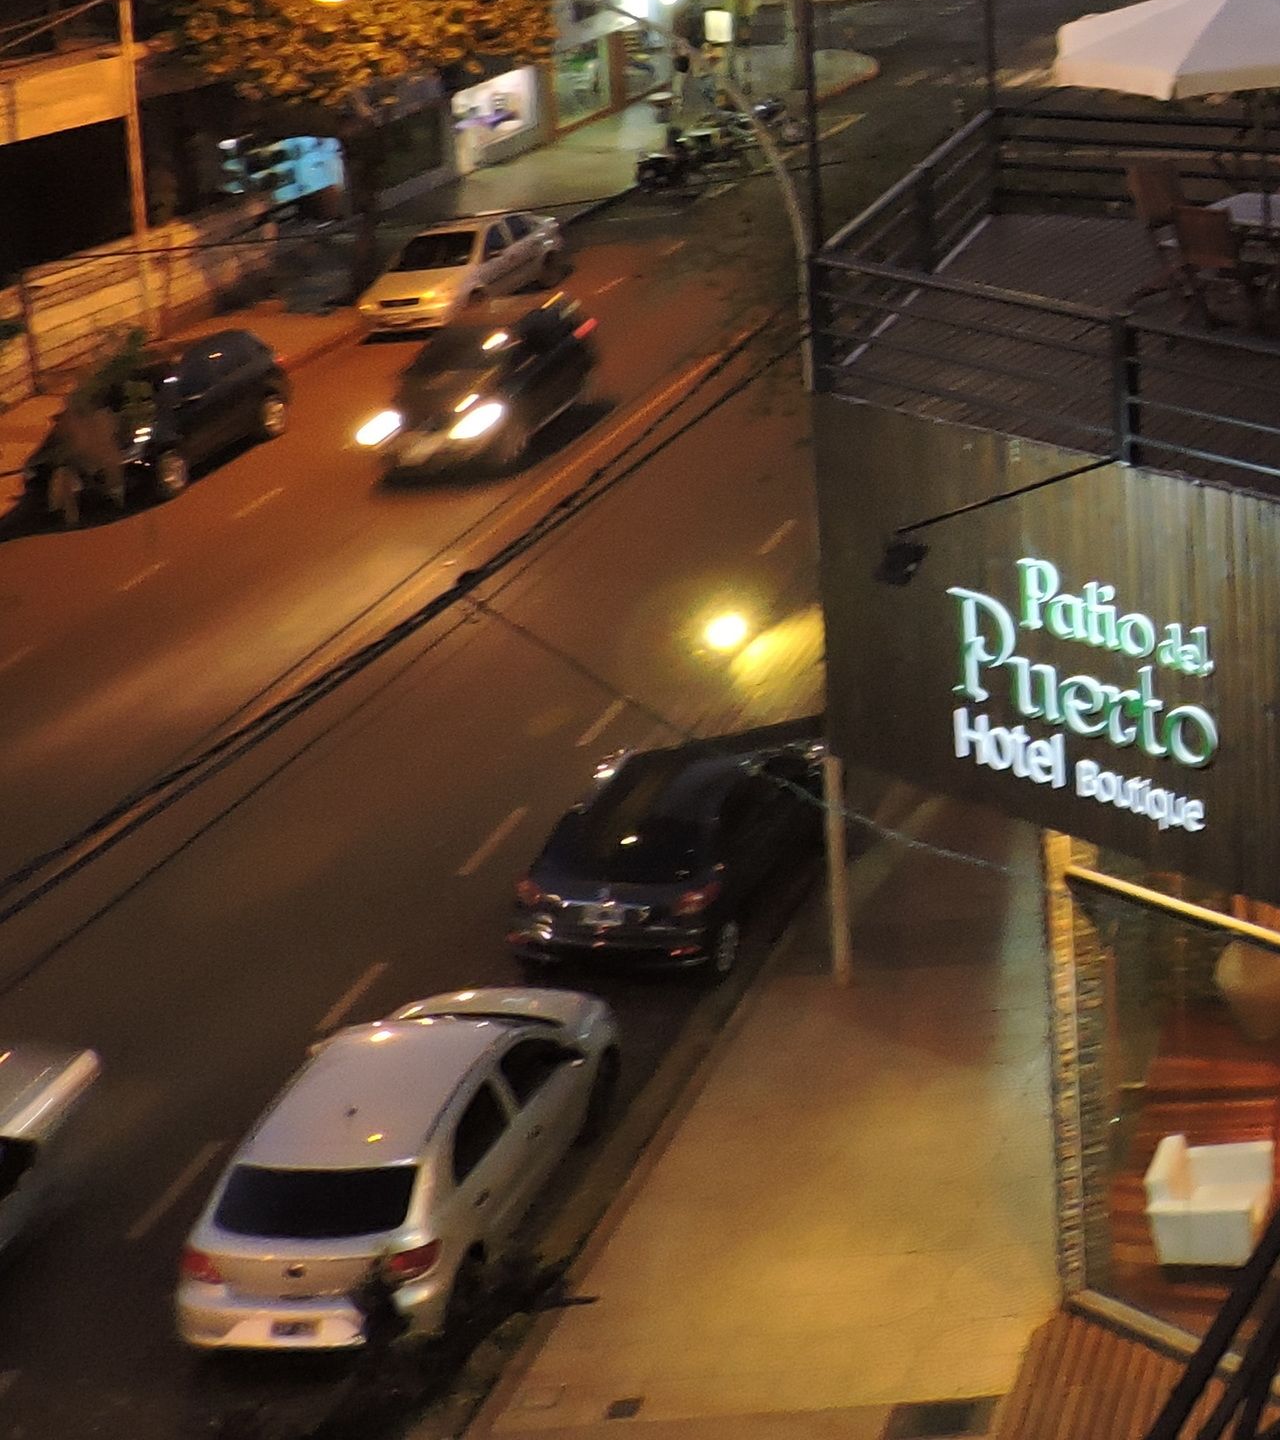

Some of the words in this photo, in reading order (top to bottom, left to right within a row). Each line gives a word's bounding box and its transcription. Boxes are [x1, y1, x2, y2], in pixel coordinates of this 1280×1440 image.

[946, 587, 1219, 768] Puerto
[1017, 558, 1155, 658] Patio
[1156, 623, 1214, 677] del
[952, 707, 1066, 789] Hotel
[1075, 759, 1206, 832] Boutique
